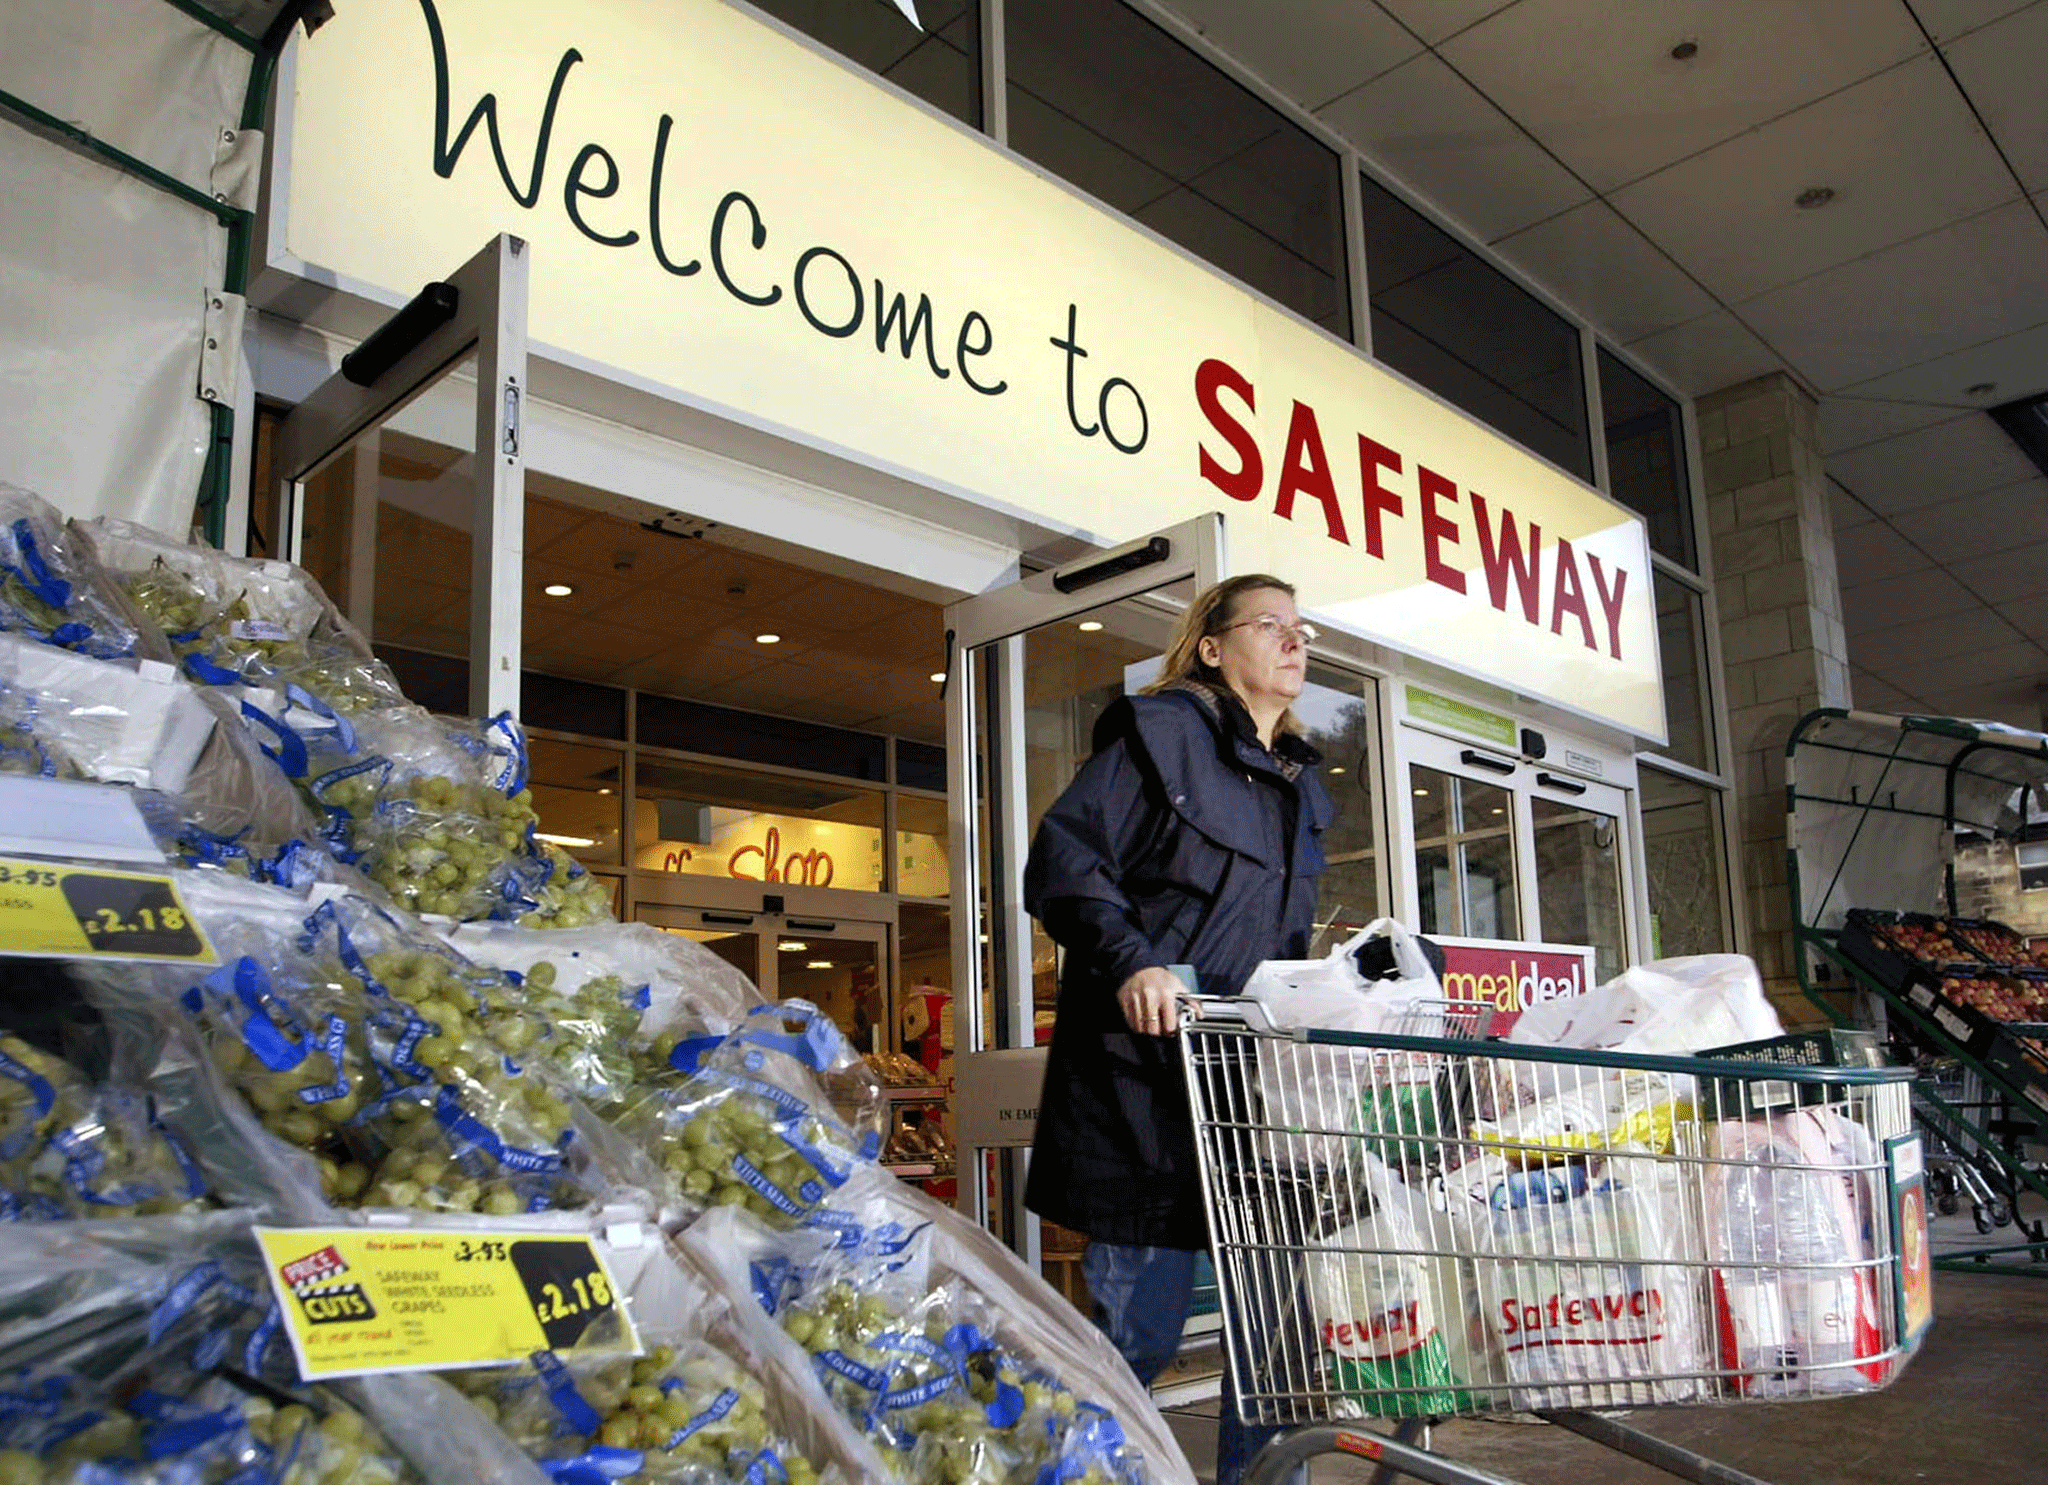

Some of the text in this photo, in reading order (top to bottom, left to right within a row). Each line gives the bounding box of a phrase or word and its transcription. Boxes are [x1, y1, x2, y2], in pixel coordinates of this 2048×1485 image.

[420, 0, 1627, 661] Welcome to SAFEWAY
[85, 906, 186, 934] £2.18
[999, 1108, 1012, 1120] IN
[305, 1293, 368, 1320] CUTS
[538, 1271, 615, 1324] £2.18
